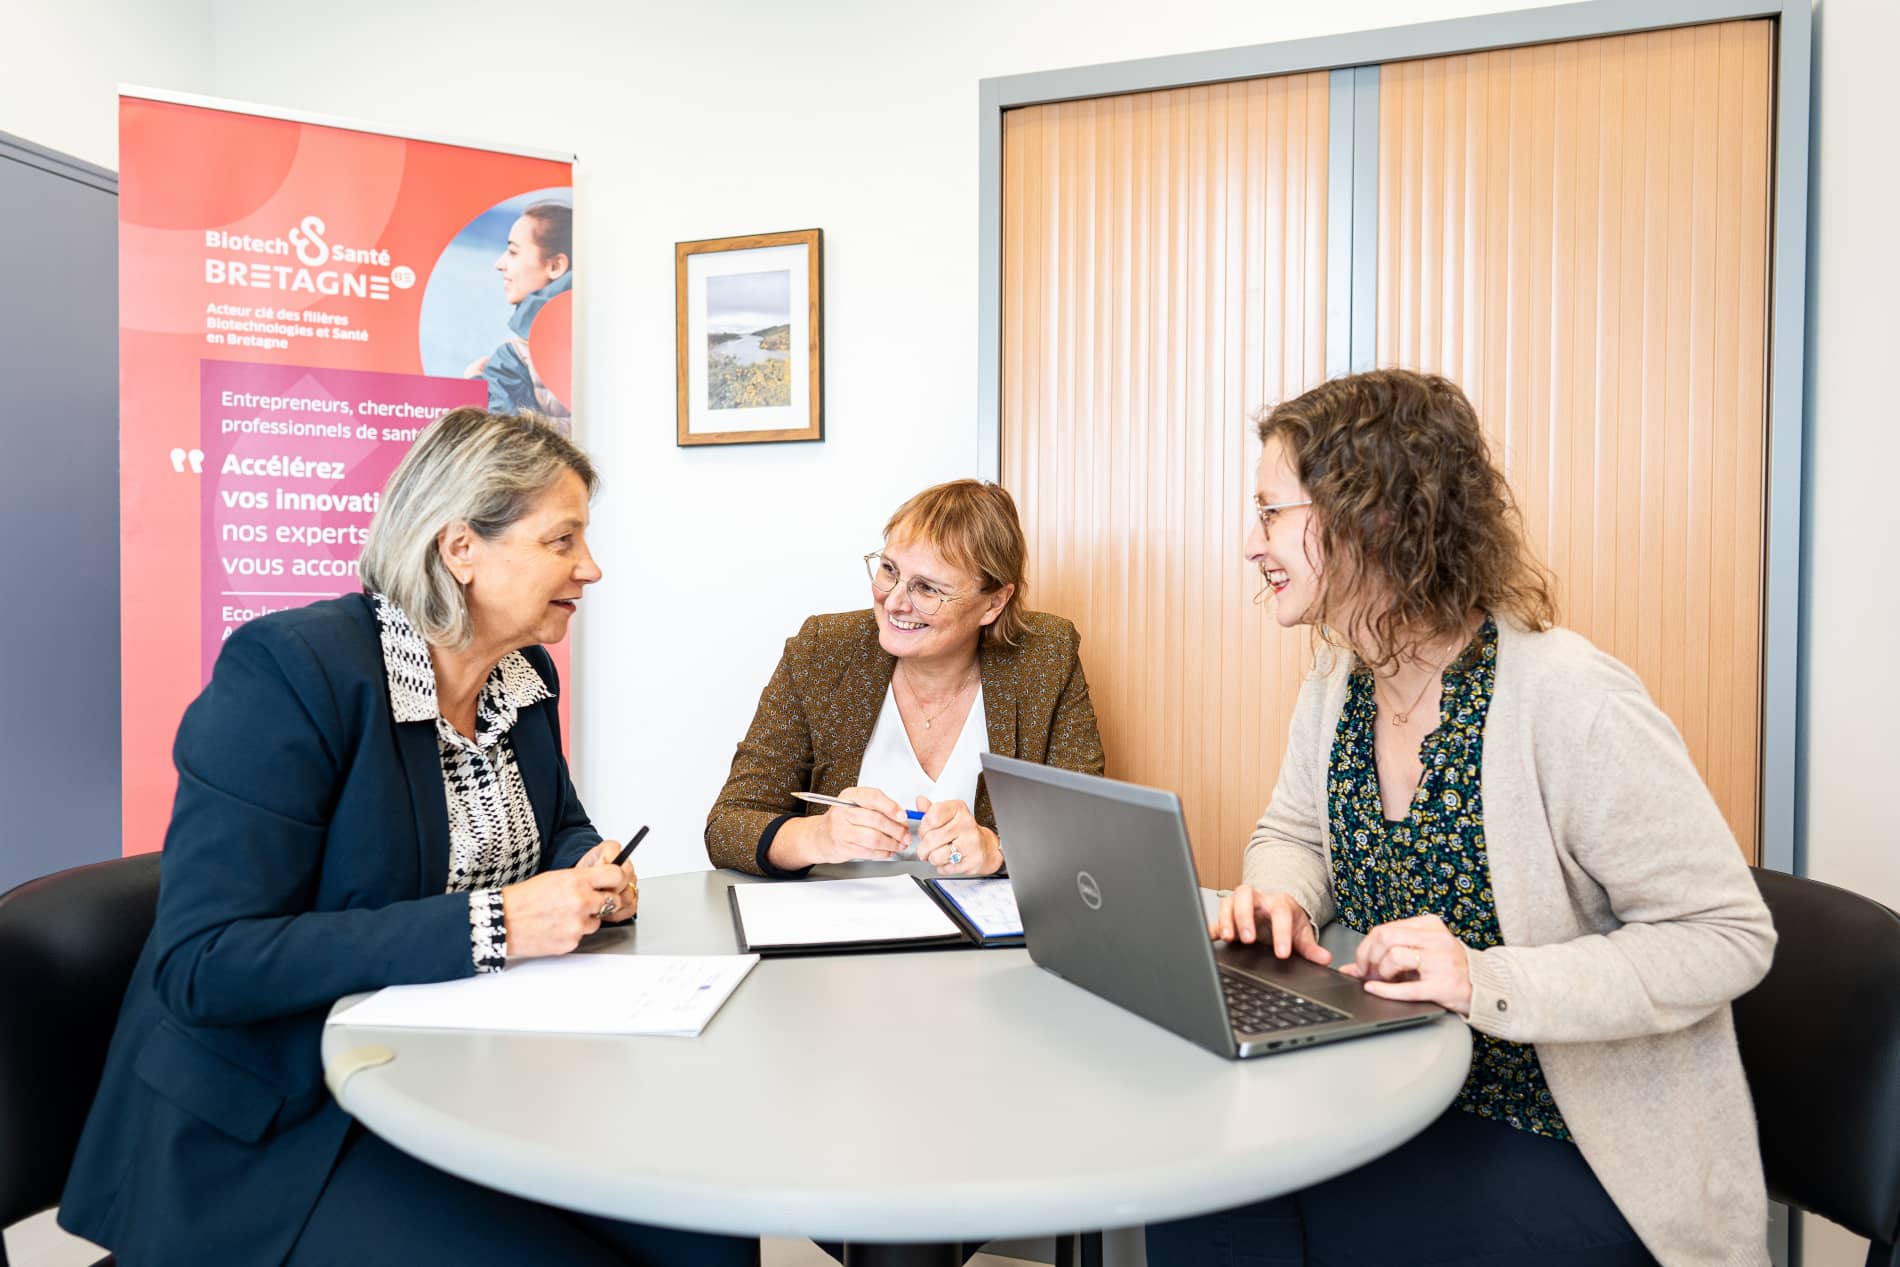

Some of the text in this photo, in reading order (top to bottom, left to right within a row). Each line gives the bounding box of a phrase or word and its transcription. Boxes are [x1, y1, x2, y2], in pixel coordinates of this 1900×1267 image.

[205, 230, 288, 256] Biotech
[331, 245, 391, 267] Santé
[205, 259, 390, 301] BRETAGNE
[206, 303, 349, 326] Acteur clé des filières
[206, 318, 369, 342] Biotechnologies et Santé
[206, 334, 288, 350] en Bretagne
[221, 391, 354, 415] Entrepreneurs,
[221, 417, 424, 442] professionnels de sant
[221, 453, 345, 480] Accélérez
[221, 488, 380, 513] vos innovati
[222, 524, 369, 547] nos experts
[222, 557, 284, 576] vous
